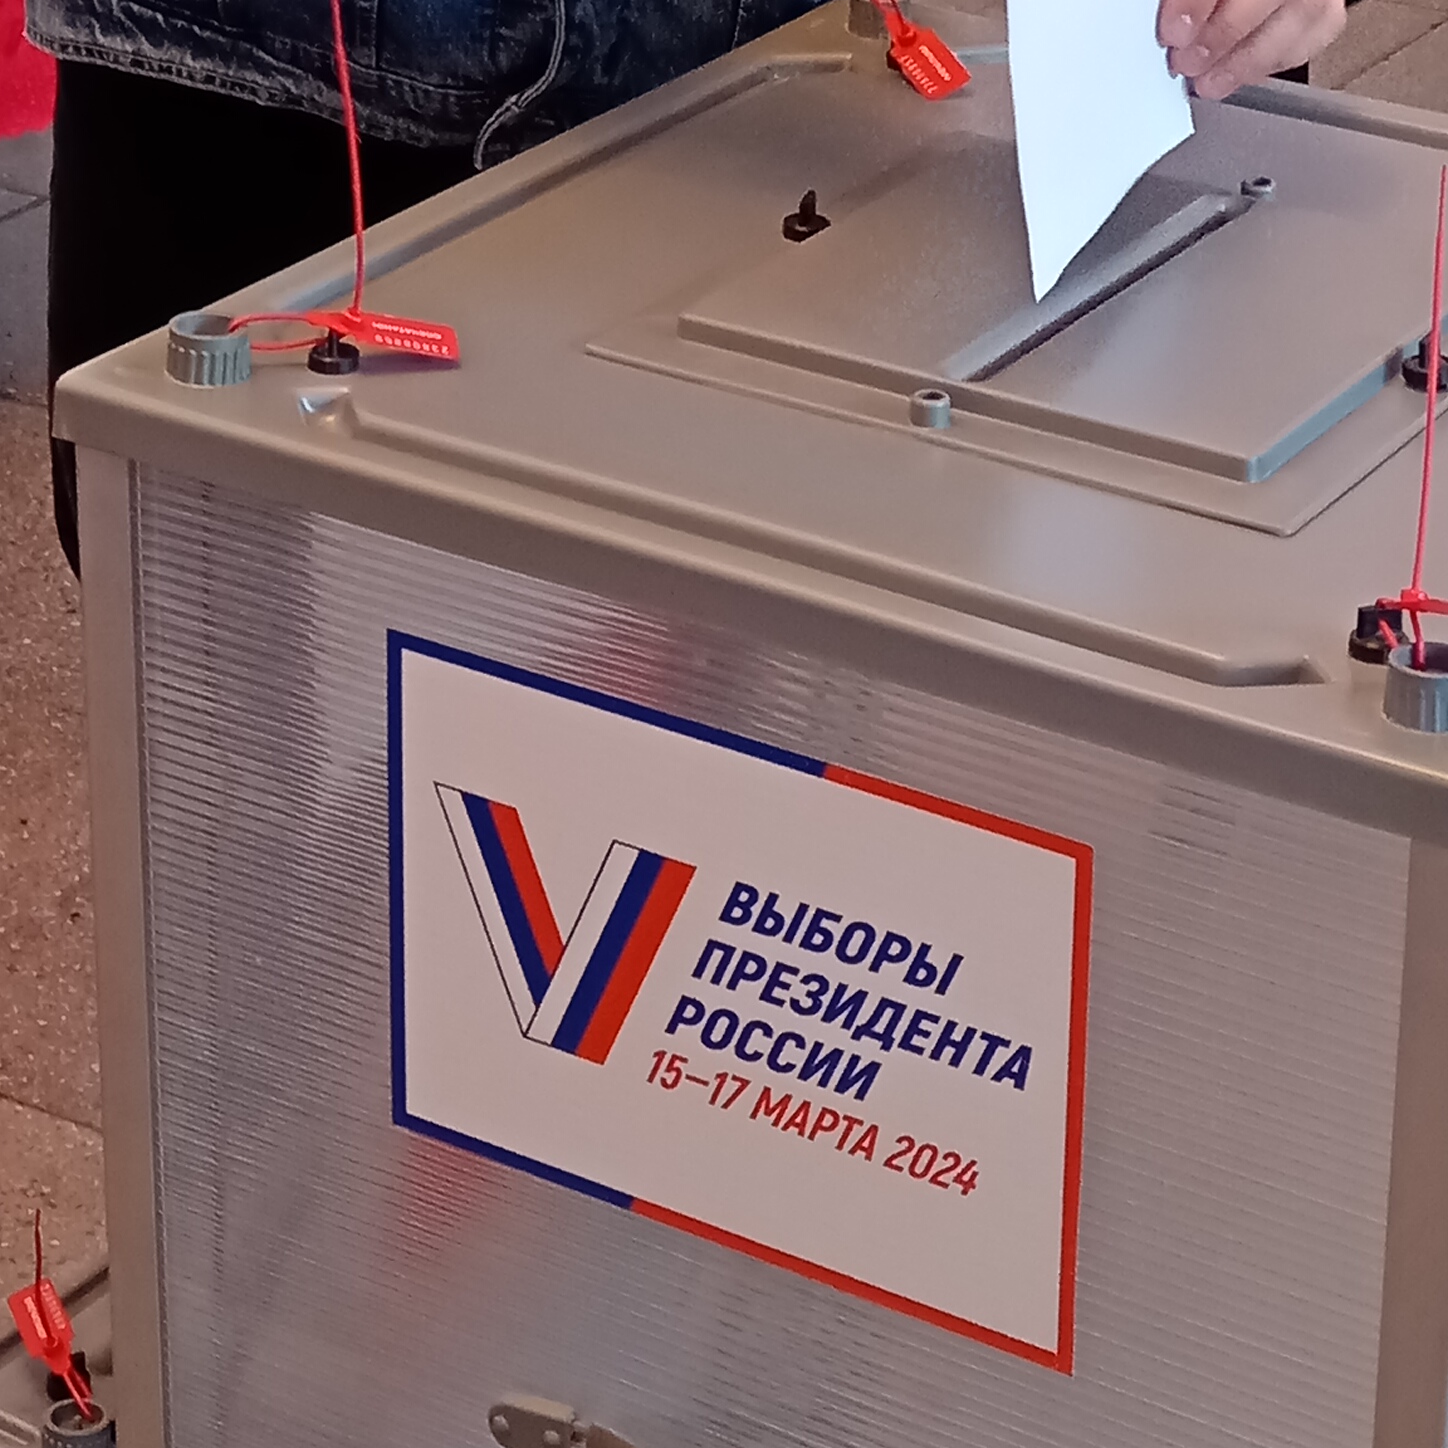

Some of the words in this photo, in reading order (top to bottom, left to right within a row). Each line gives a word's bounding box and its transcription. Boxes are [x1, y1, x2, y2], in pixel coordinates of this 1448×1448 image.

[719, 881, 964, 997] ВЫБОРЫ
[665, 995, 882, 1102] РОССИИ
[692, 938, 1034, 1091] ПРЕЗИДЕНТА
[751, 1086, 881, 1163] МАРТА
[883, 1134, 980, 1197] 2024
